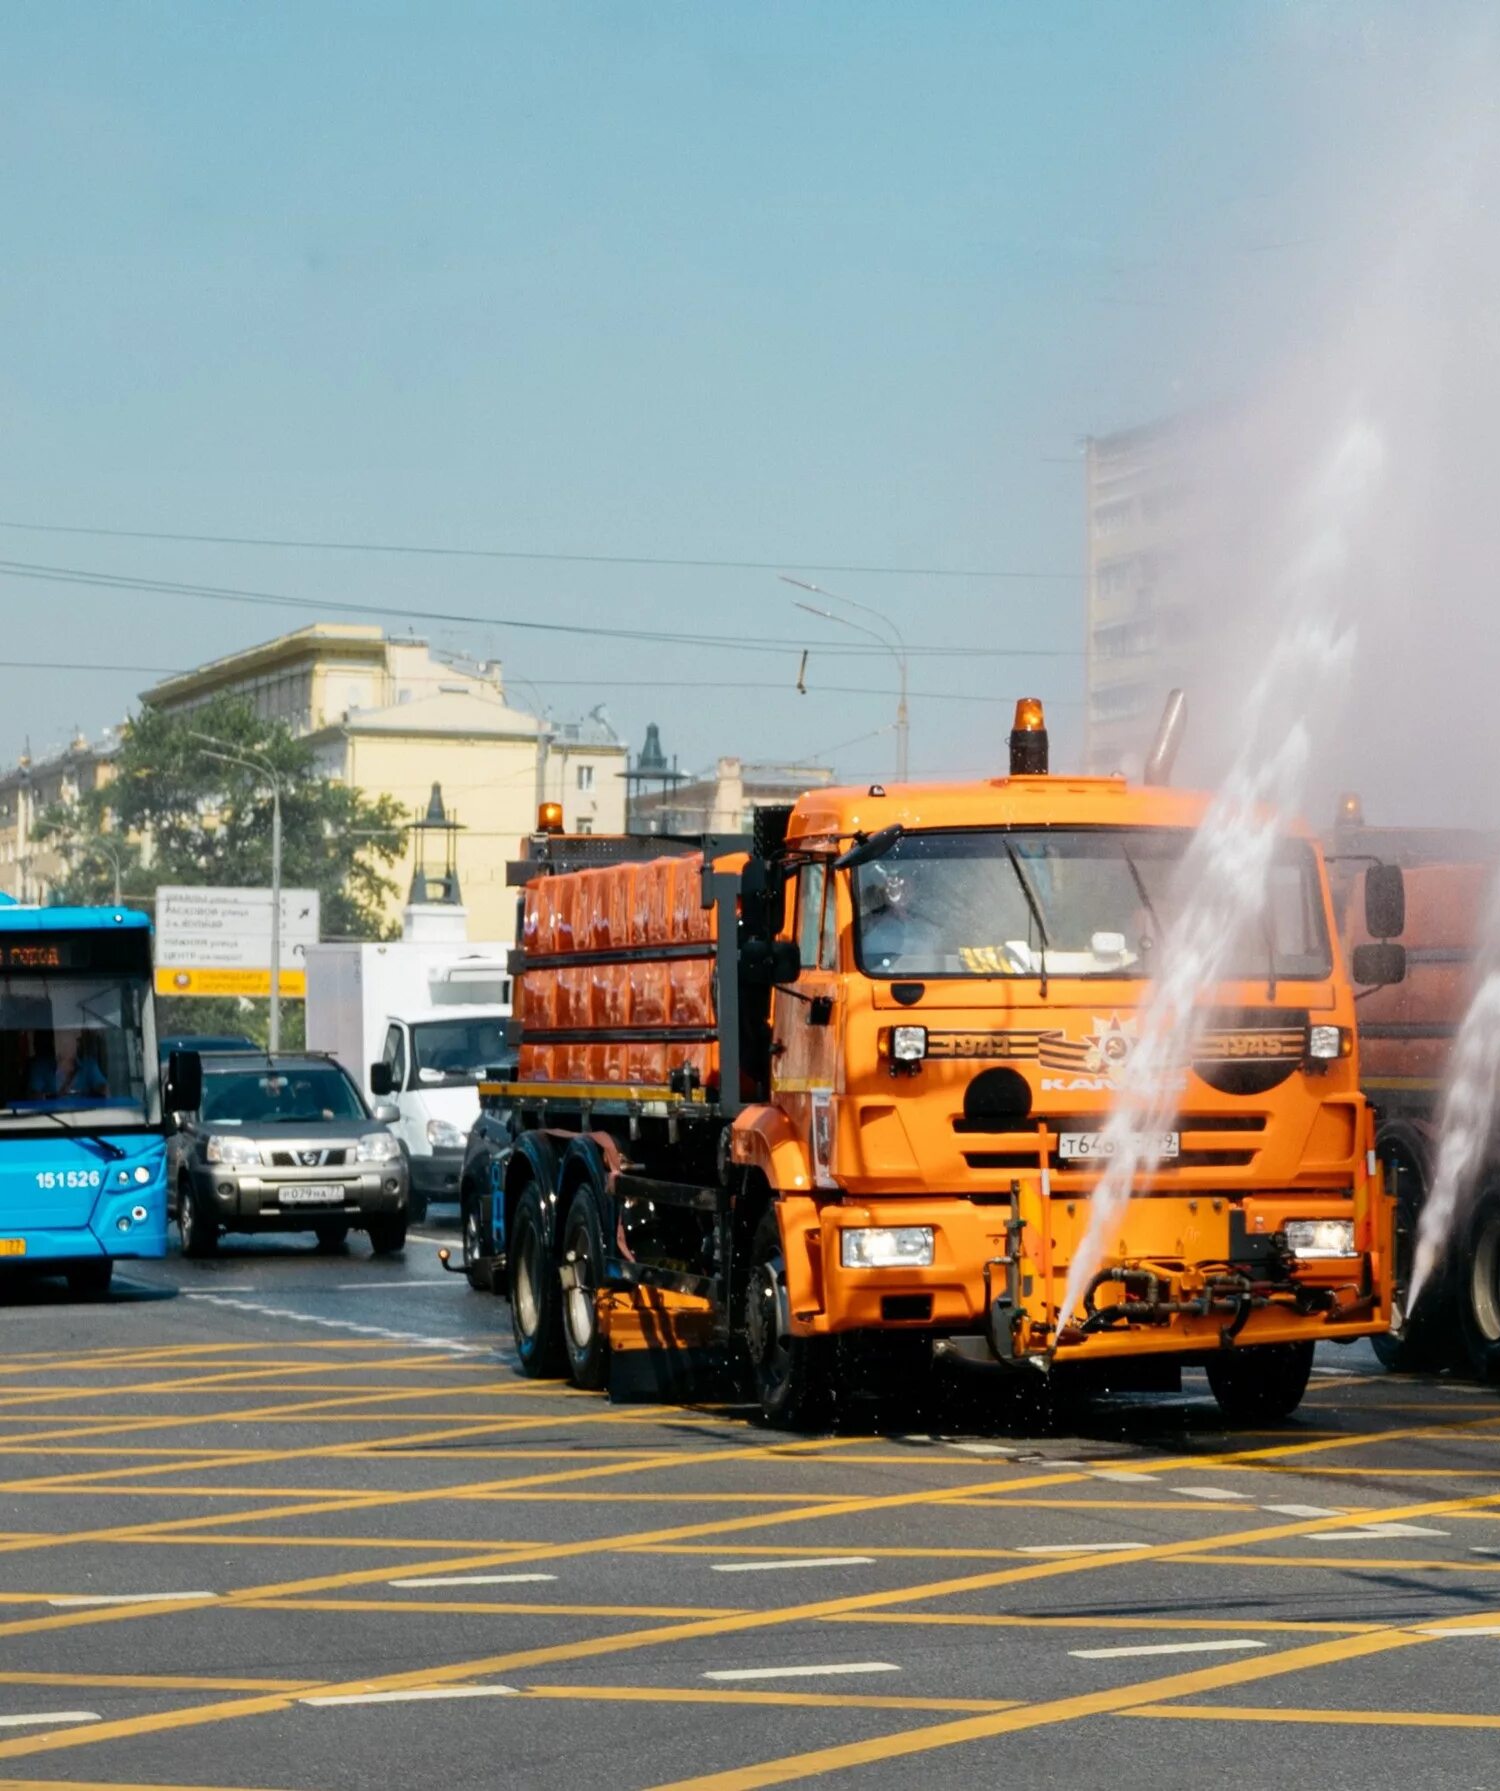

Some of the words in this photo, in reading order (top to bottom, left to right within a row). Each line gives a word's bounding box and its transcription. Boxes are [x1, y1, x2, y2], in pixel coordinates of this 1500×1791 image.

[947, 1034, 1009, 1056] 1941
[1217, 1034, 1282, 1056] 1945
[36, 1170, 100, 1188] 151526
